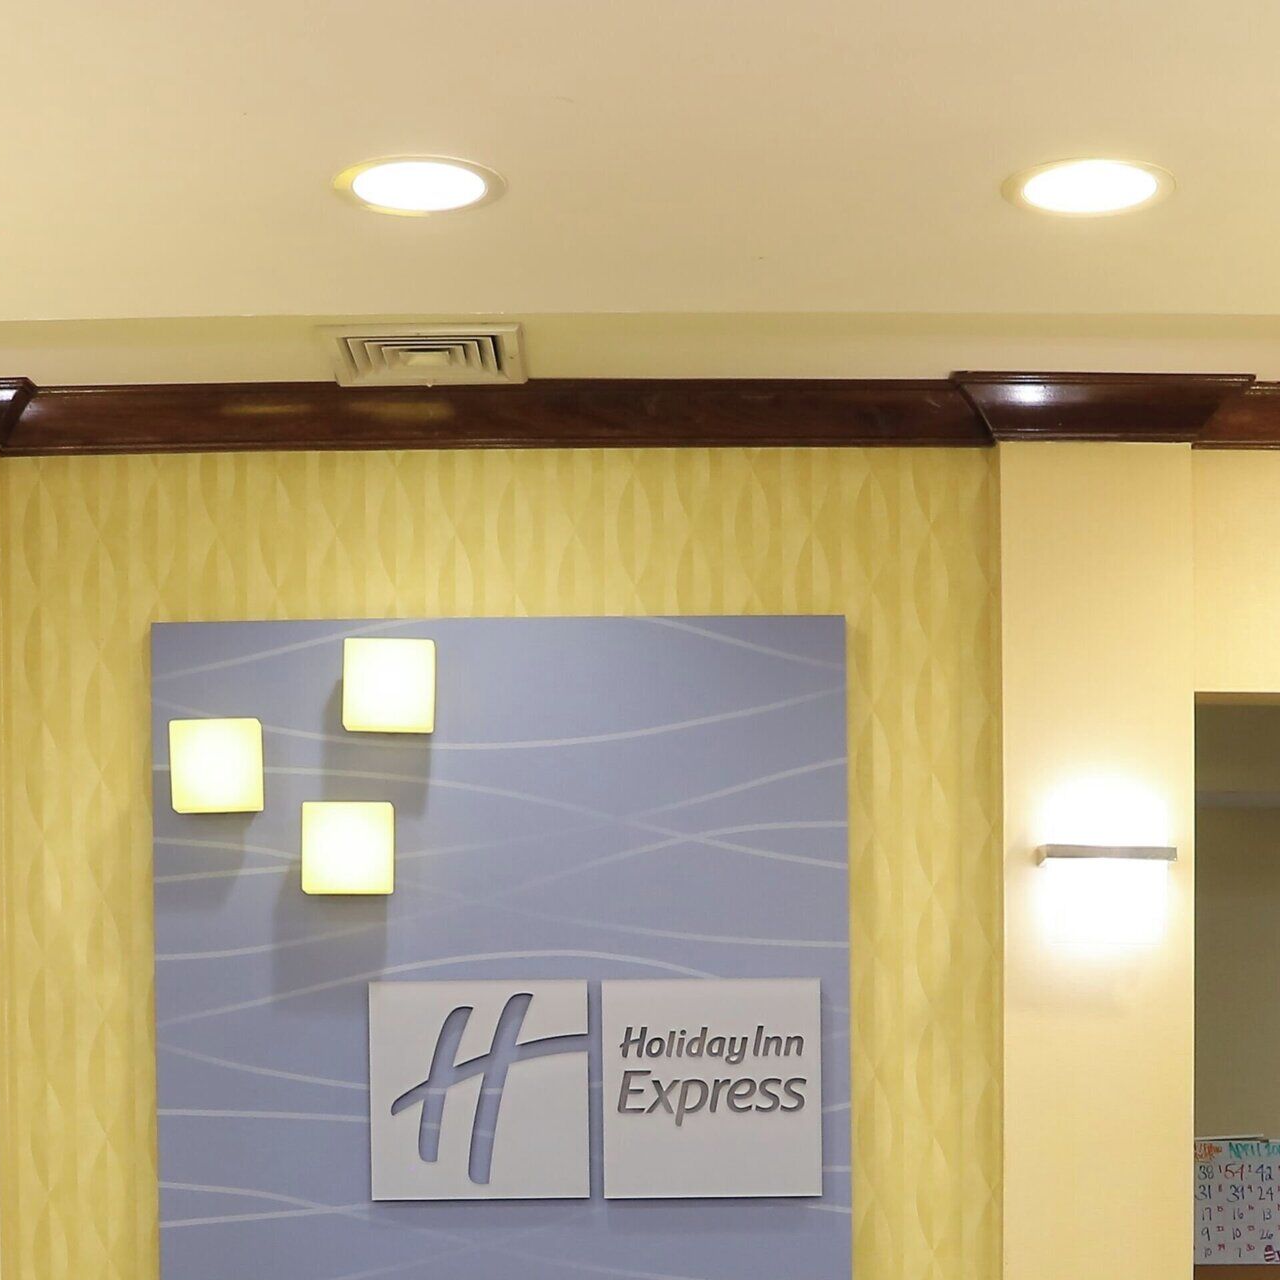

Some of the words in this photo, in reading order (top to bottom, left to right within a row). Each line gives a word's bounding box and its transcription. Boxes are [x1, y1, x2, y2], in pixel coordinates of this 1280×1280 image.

[619, 1025, 747, 1065] Holiday
[754, 1024, 804, 1057] Inn
[616, 1069, 808, 1127] Express
[1197, 1164, 1214, 1181] 38
[1255, 1163, 1274, 1182] 42
[1195, 1184, 1212, 1201] 31
